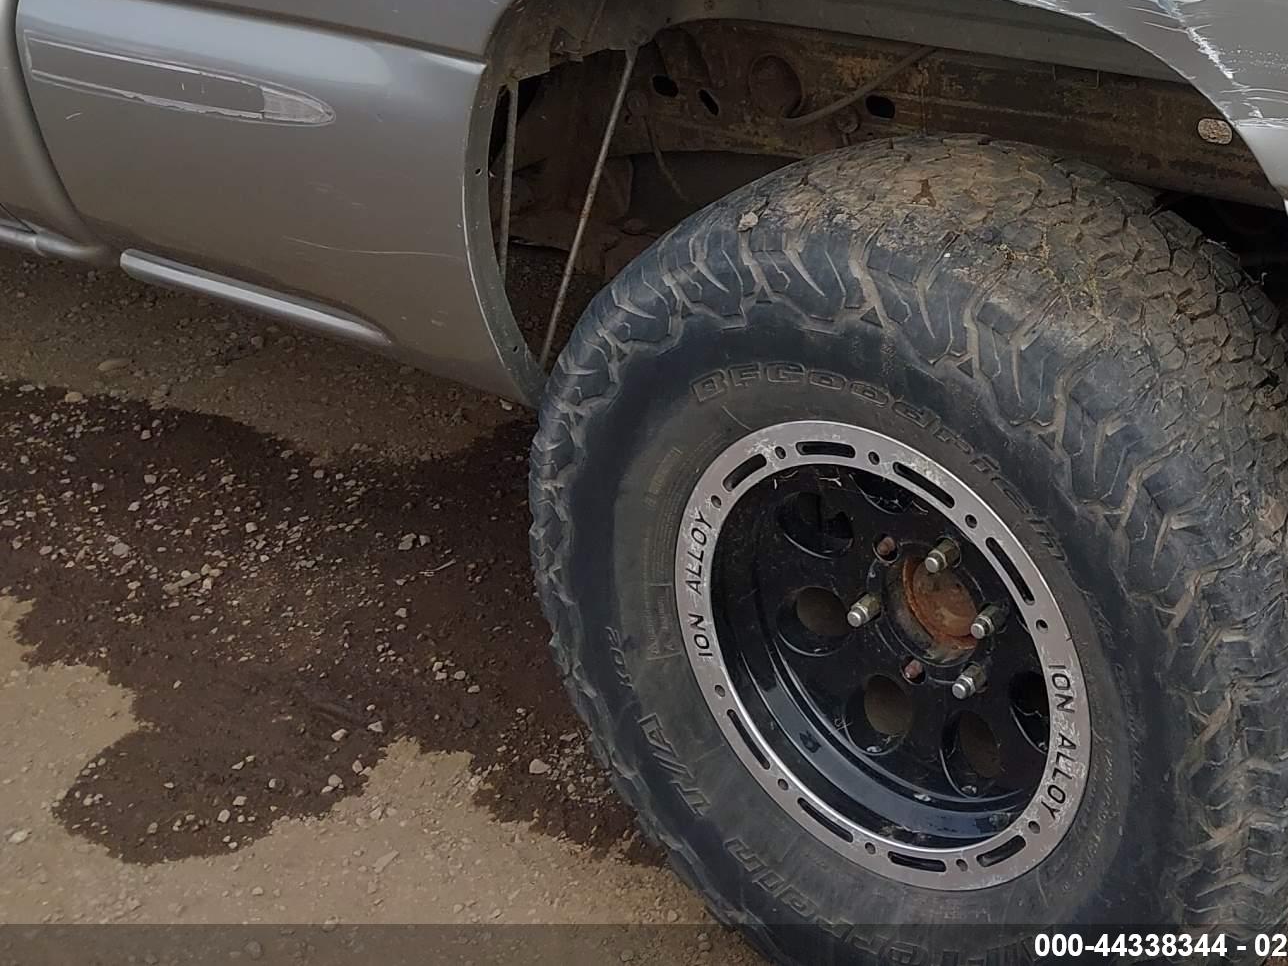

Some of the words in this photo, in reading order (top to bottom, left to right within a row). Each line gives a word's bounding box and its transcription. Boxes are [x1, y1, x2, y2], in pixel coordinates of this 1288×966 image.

[685, 509, 713, 596] ALLOY
[688, 613, 713, 657] ION
[1048, 664, 1075, 713] ION
[1040, 732, 1077, 820] ALLOY
